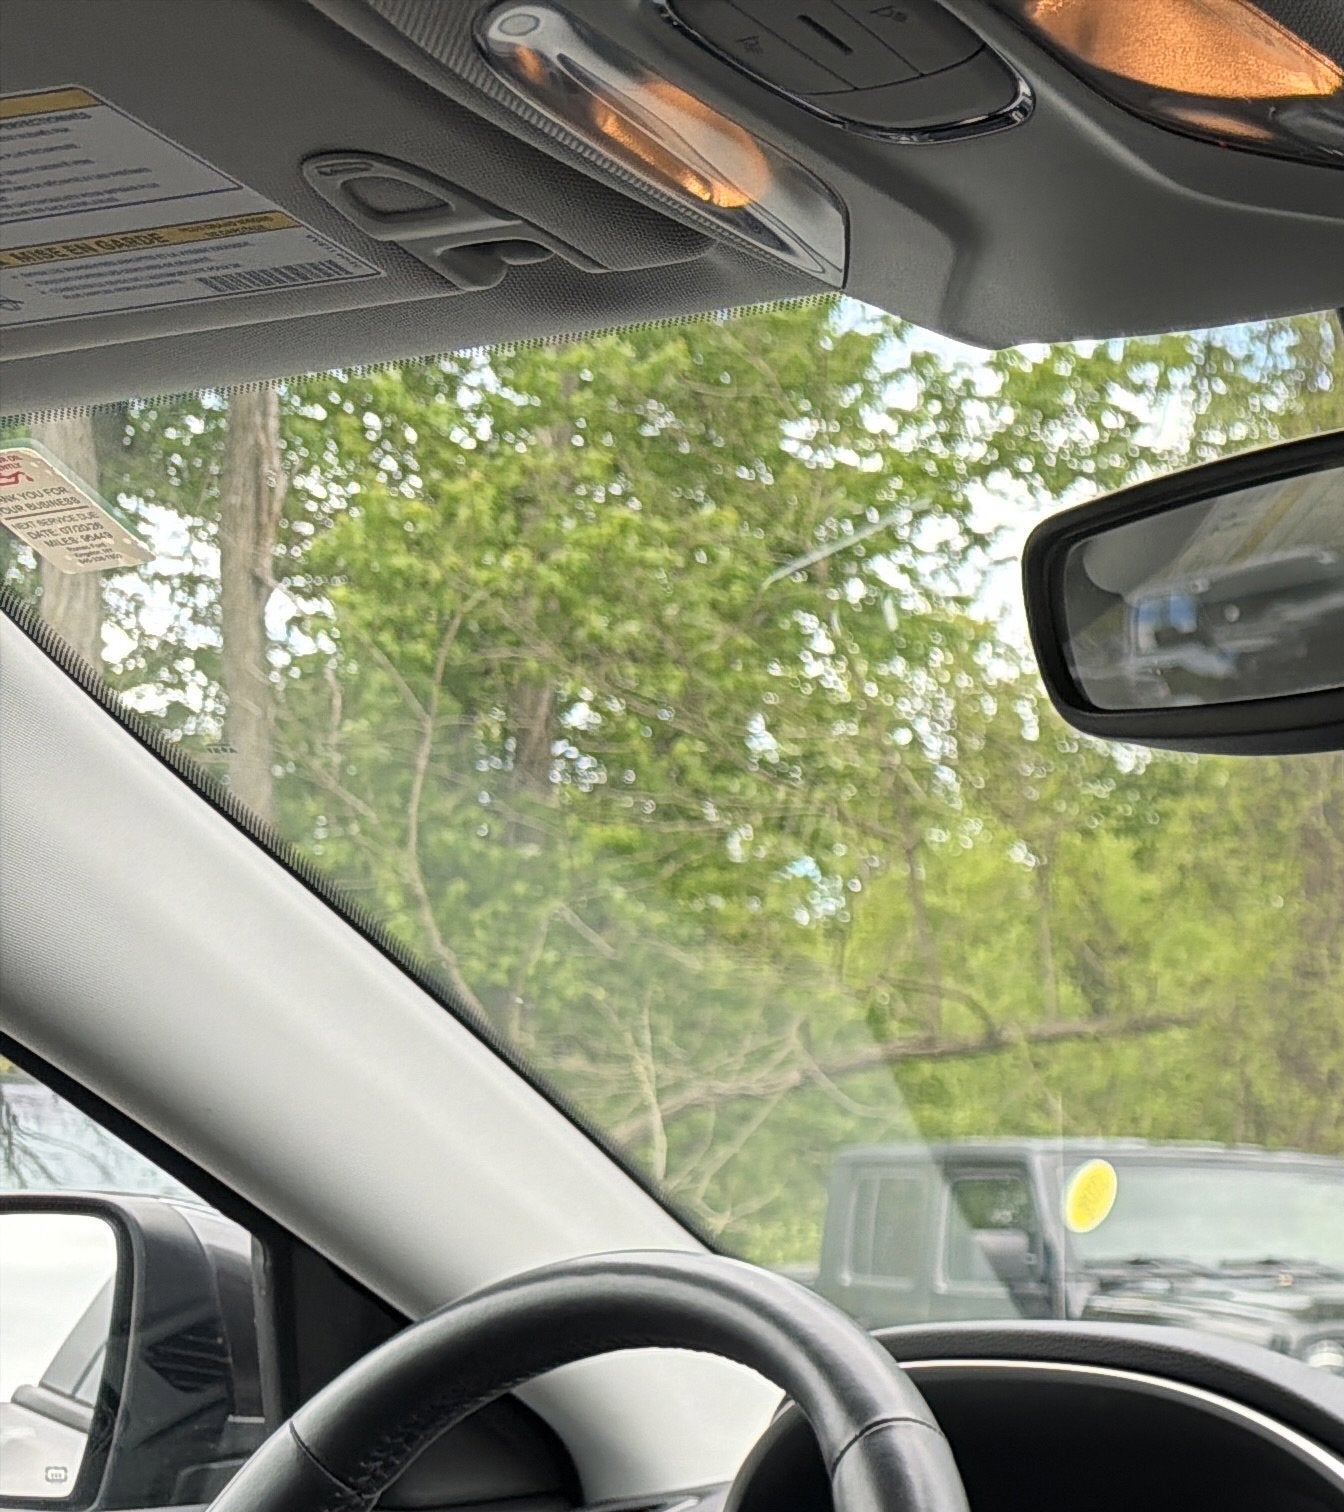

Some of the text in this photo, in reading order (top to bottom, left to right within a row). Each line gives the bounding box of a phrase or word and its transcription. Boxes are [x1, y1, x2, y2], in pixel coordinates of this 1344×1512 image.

[9, 248, 67, 263] MISE
[62, 243, 98, 255] EN
[95, 232, 169, 250] GARDE
[17, 490, 43, 500] YOU
[43, 487, 70, 496] FOR
[24, 497, 80, 511] BUSINESS
[37, 514, 77, 527] SERVICE
